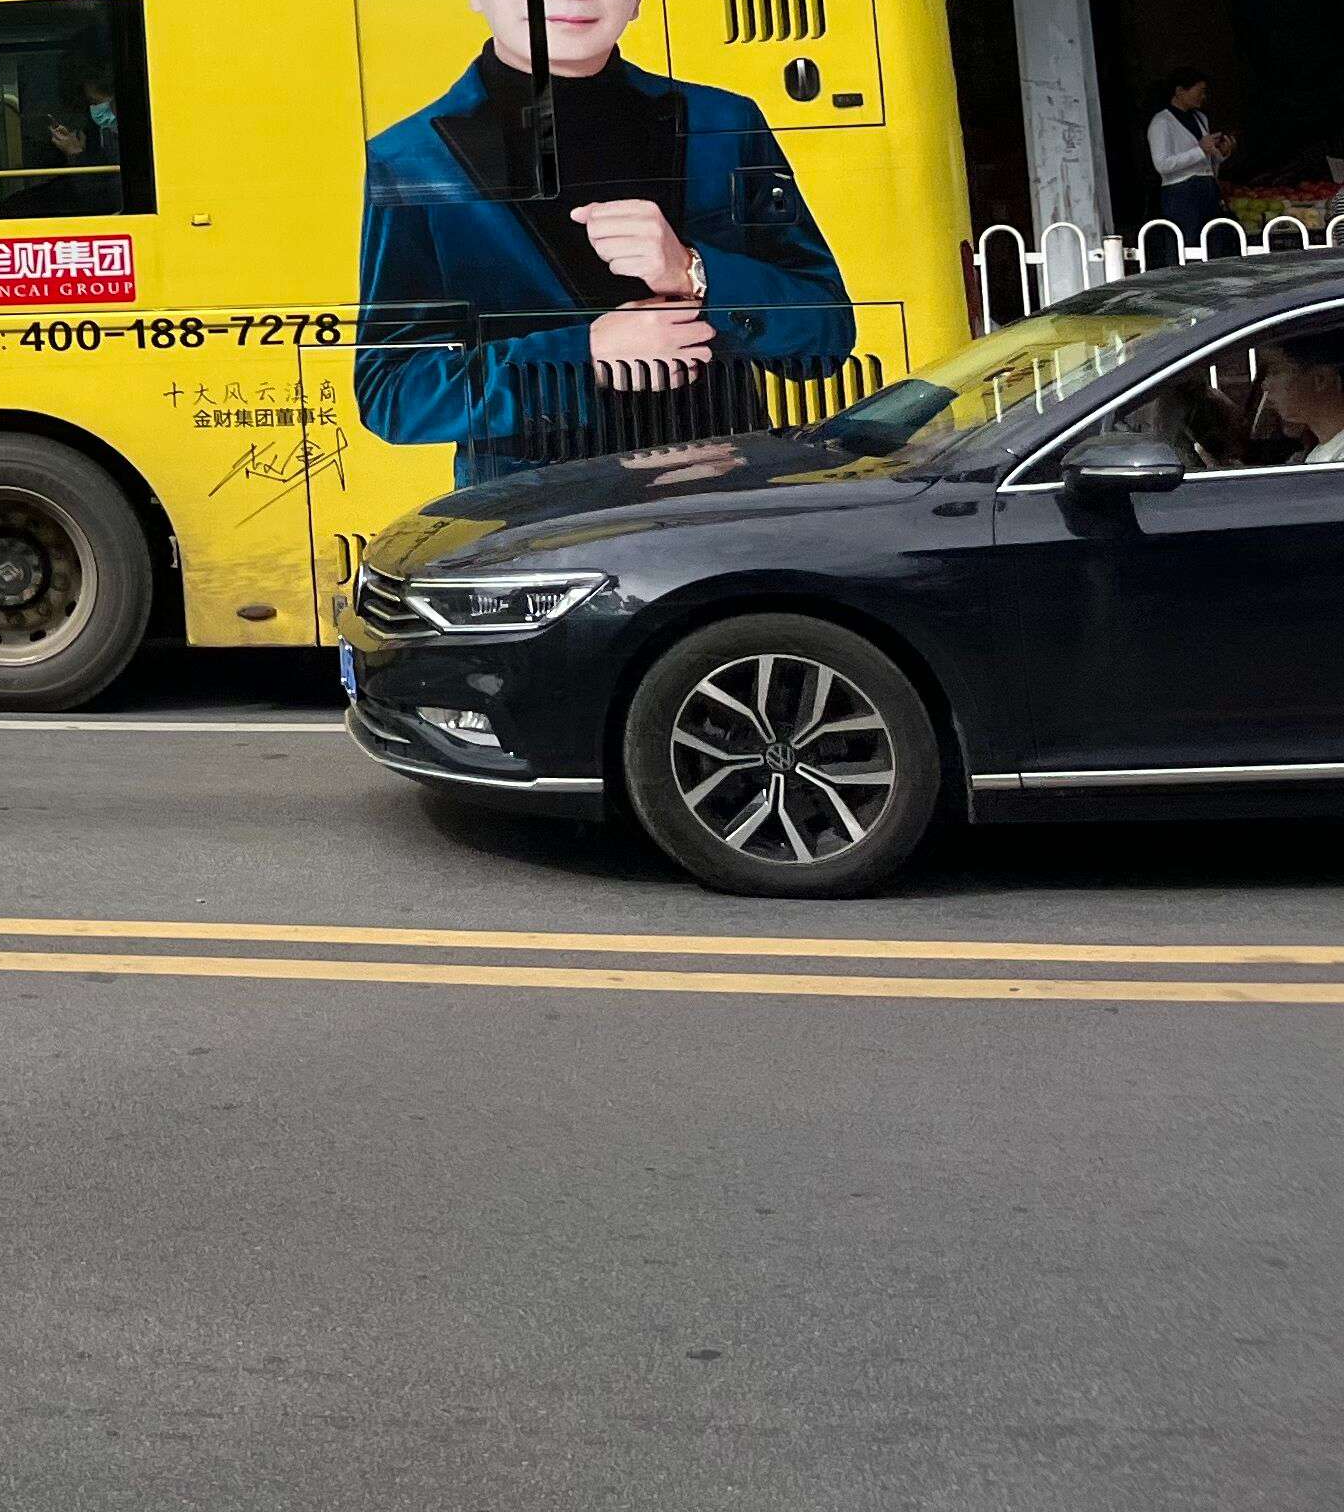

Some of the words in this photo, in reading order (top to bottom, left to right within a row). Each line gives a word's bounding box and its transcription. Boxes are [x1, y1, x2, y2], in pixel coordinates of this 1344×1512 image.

[59, 282, 134, 297] GROUP
[20, 312, 341, 354] 400-188-7278
[193, 407, 338, 429] 金财集团董事长
